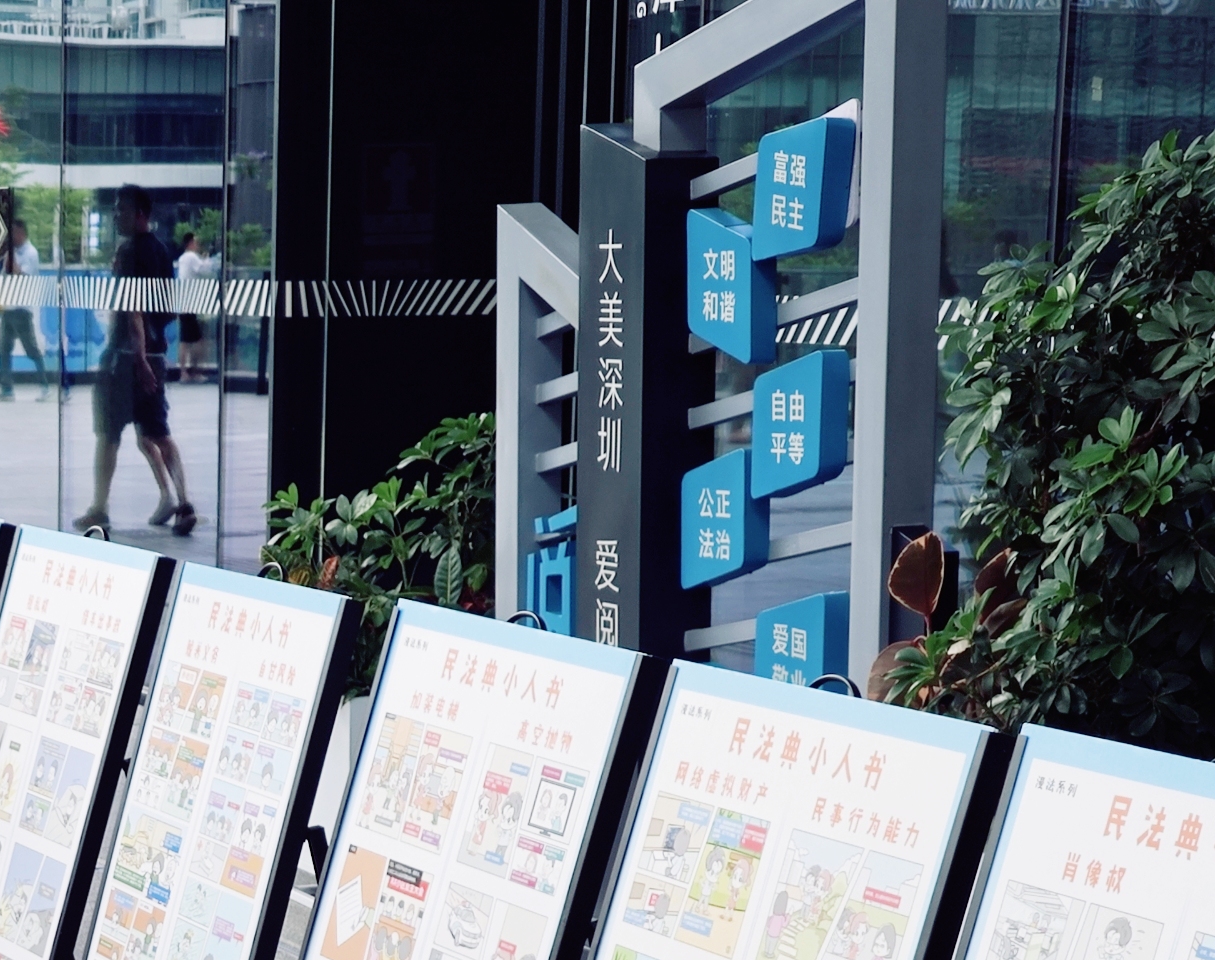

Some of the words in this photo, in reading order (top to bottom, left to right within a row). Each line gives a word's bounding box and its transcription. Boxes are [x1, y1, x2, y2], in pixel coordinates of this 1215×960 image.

[772, 150, 807, 190] 富强
[770, 194, 805, 232] 民主
[702, 247, 736, 283] 文明
[702, 290, 736, 324] 和谐
[597, 228, 624, 473] 大美深圳
[770, 389, 805, 425] 自由
[770, 432, 805, 467] 平等
[698, 486, 731, 520] 公正
[698, 528, 731, 562] 法治
[208, 601, 291, 649] 民法典小人书
[772, 623, 806, 662] 爱国
[441, 648, 564, 710] 民法典小人书
[410, 690, 460, 721] 加装电梯
[517, 719, 573, 754] 高空抛物
[728, 717, 887, 792] 民法典小人书
[674, 760, 769, 805] 网络虚拟财产
[1035, 776, 1078, 798] 漫法系列
[811, 796, 920, 849] 民事行为能力
[1103, 795, 1215, 860] 民法典
[1062, 852, 1127, 894] 肖像权
